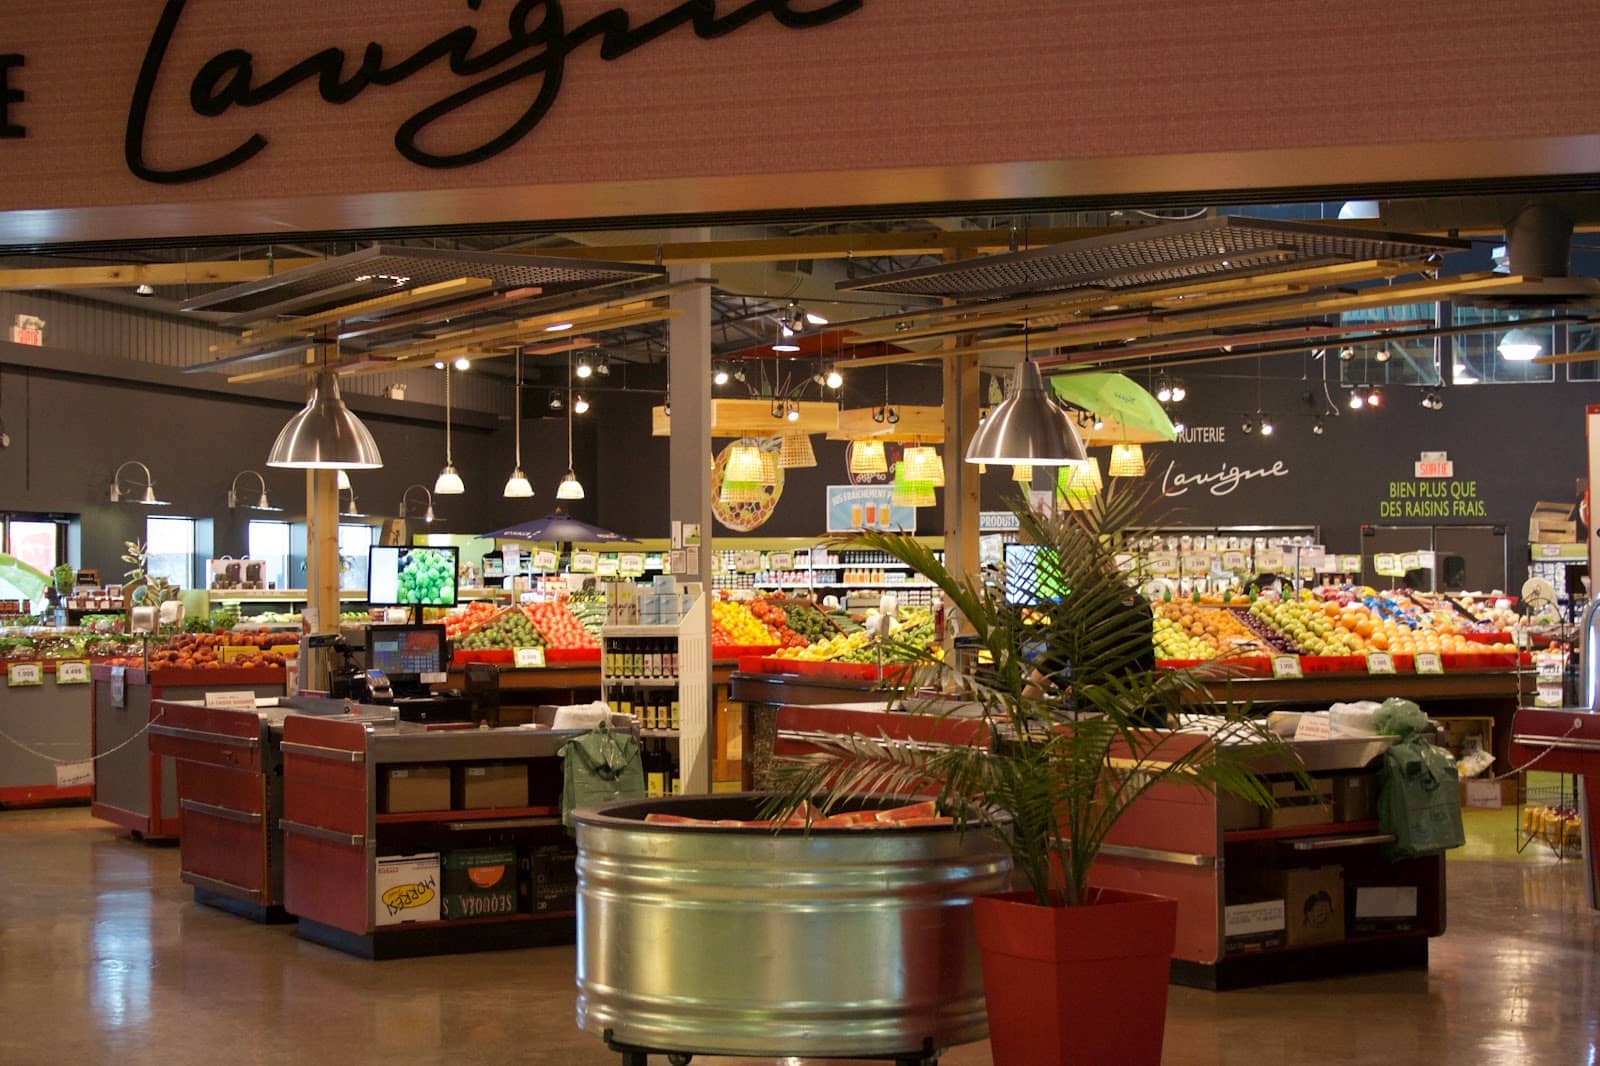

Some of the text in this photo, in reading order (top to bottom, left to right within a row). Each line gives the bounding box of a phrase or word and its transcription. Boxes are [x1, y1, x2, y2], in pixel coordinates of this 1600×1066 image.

[1175, 426, 1225, 443] RUITERIE
[1162, 460, 1289, 497] Lavigne
[1389, 481, 1477, 500] BIEN PLUS QUE
[1380, 500, 1488, 518] DES RAISINS FRAIS.
